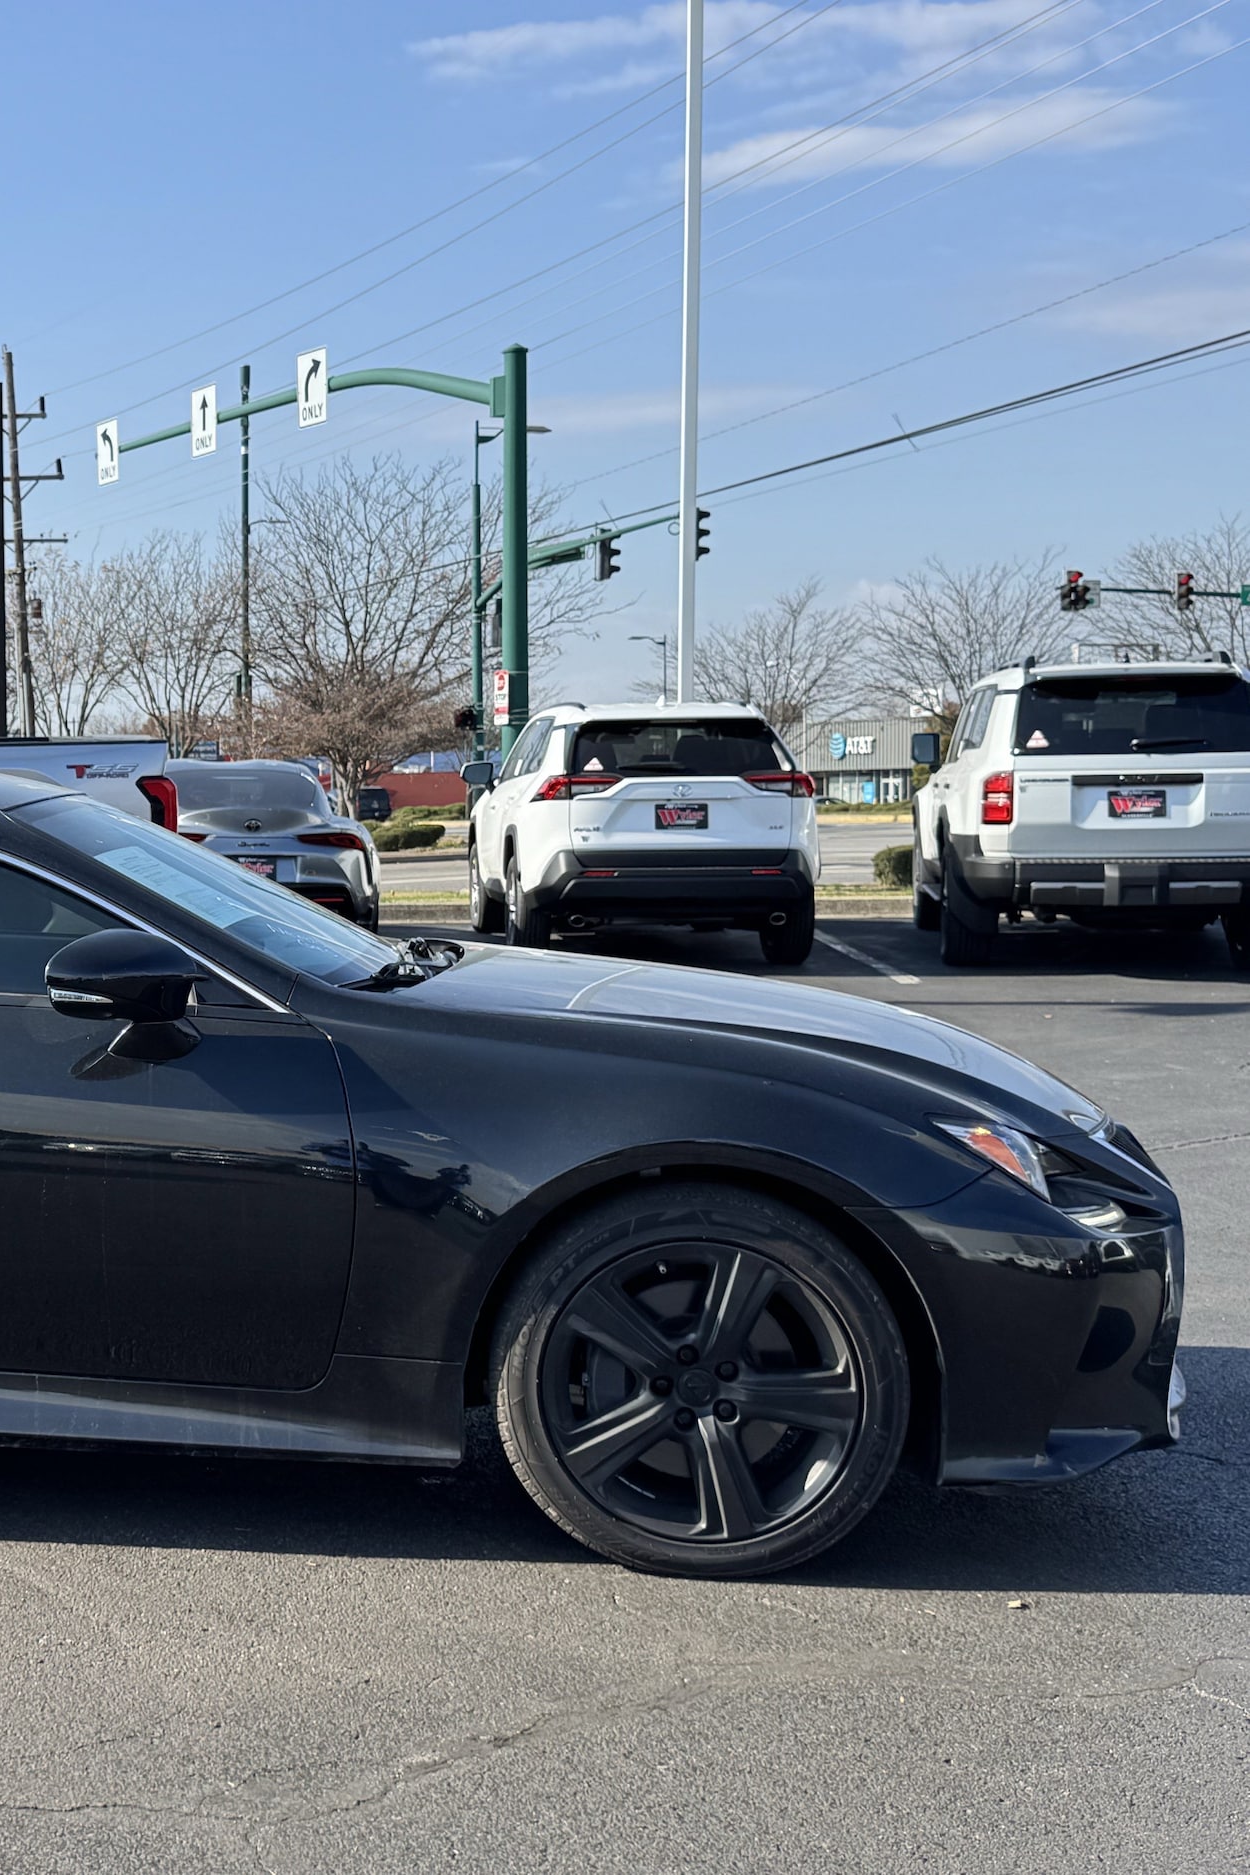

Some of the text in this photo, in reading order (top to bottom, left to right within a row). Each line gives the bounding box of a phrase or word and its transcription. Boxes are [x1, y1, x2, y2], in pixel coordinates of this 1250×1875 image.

[302, 405, 323, 422] ONLY
[195, 434, 213, 450] ONLY
[101, 465, 116, 480] ONLY
[845, 736, 873, 755] AT&T
[657, 809, 705, 826] Wyler
